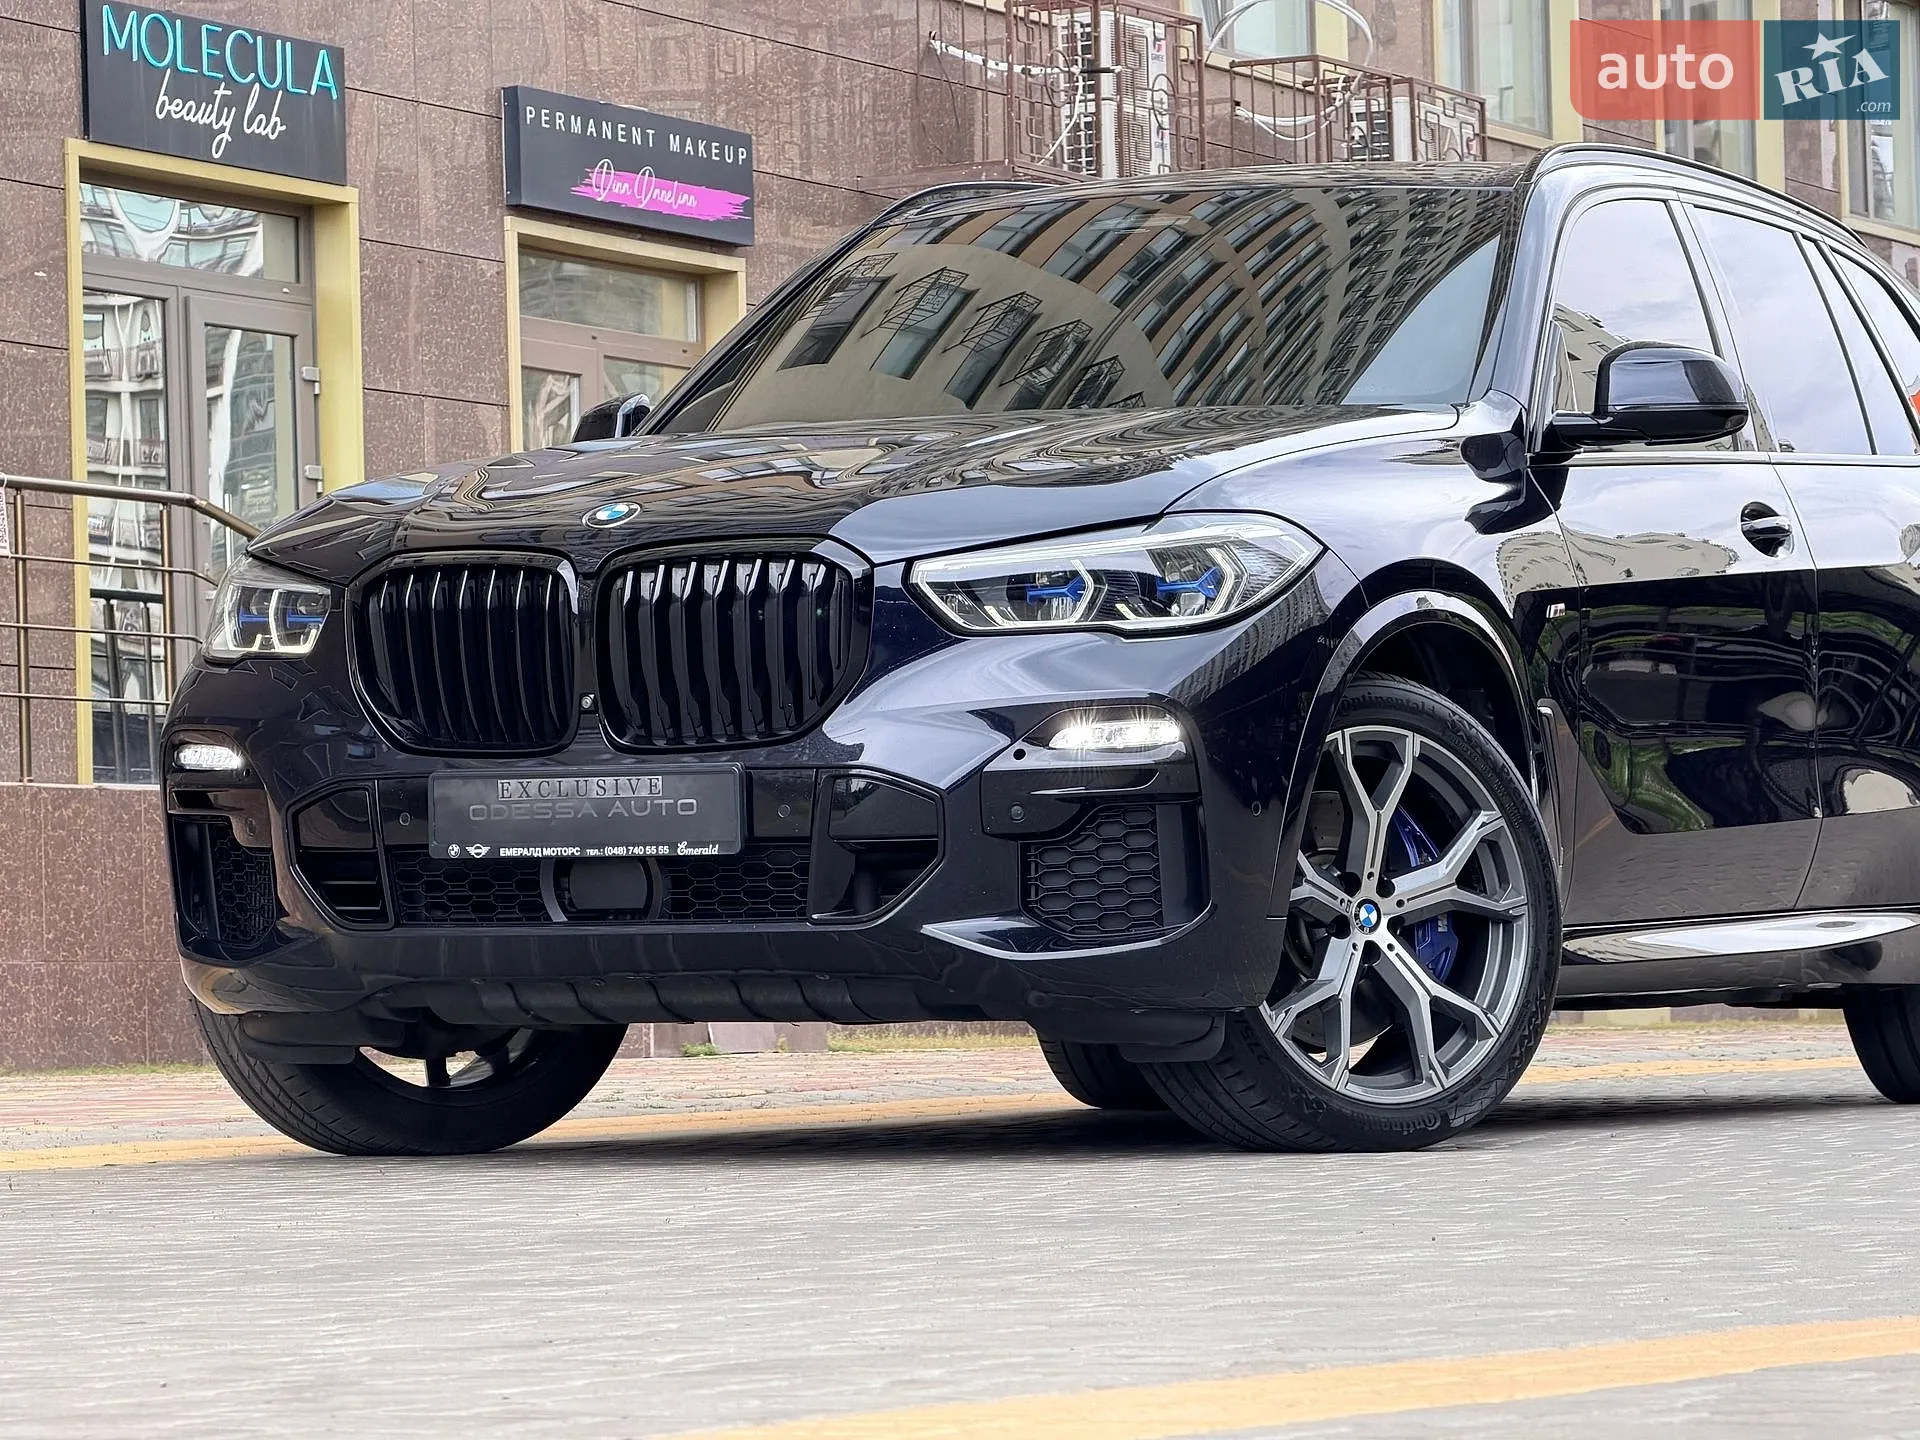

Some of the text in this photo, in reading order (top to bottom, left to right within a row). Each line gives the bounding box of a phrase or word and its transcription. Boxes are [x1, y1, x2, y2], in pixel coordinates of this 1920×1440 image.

[103, 4, 338, 100] MOLECULA
[155, 68, 287, 159] beauty lab
[526, 106, 747, 166] PERMANENT MAKEUP
[500, 777, 662, 799] EXCLUSIVE
[469, 799, 697, 820] ODESSA AUTO
[500, 847, 542, 857] ЕМЕРАЛД
[543, 846, 580, 856] МОТОРС
[604, 846, 626, 856] (048)
[628, 846, 644, 855] 740
[646, 846, 656, 854] 55
[658, 845, 669, 854] 55
[677, 841, 719, 855] Emerald
